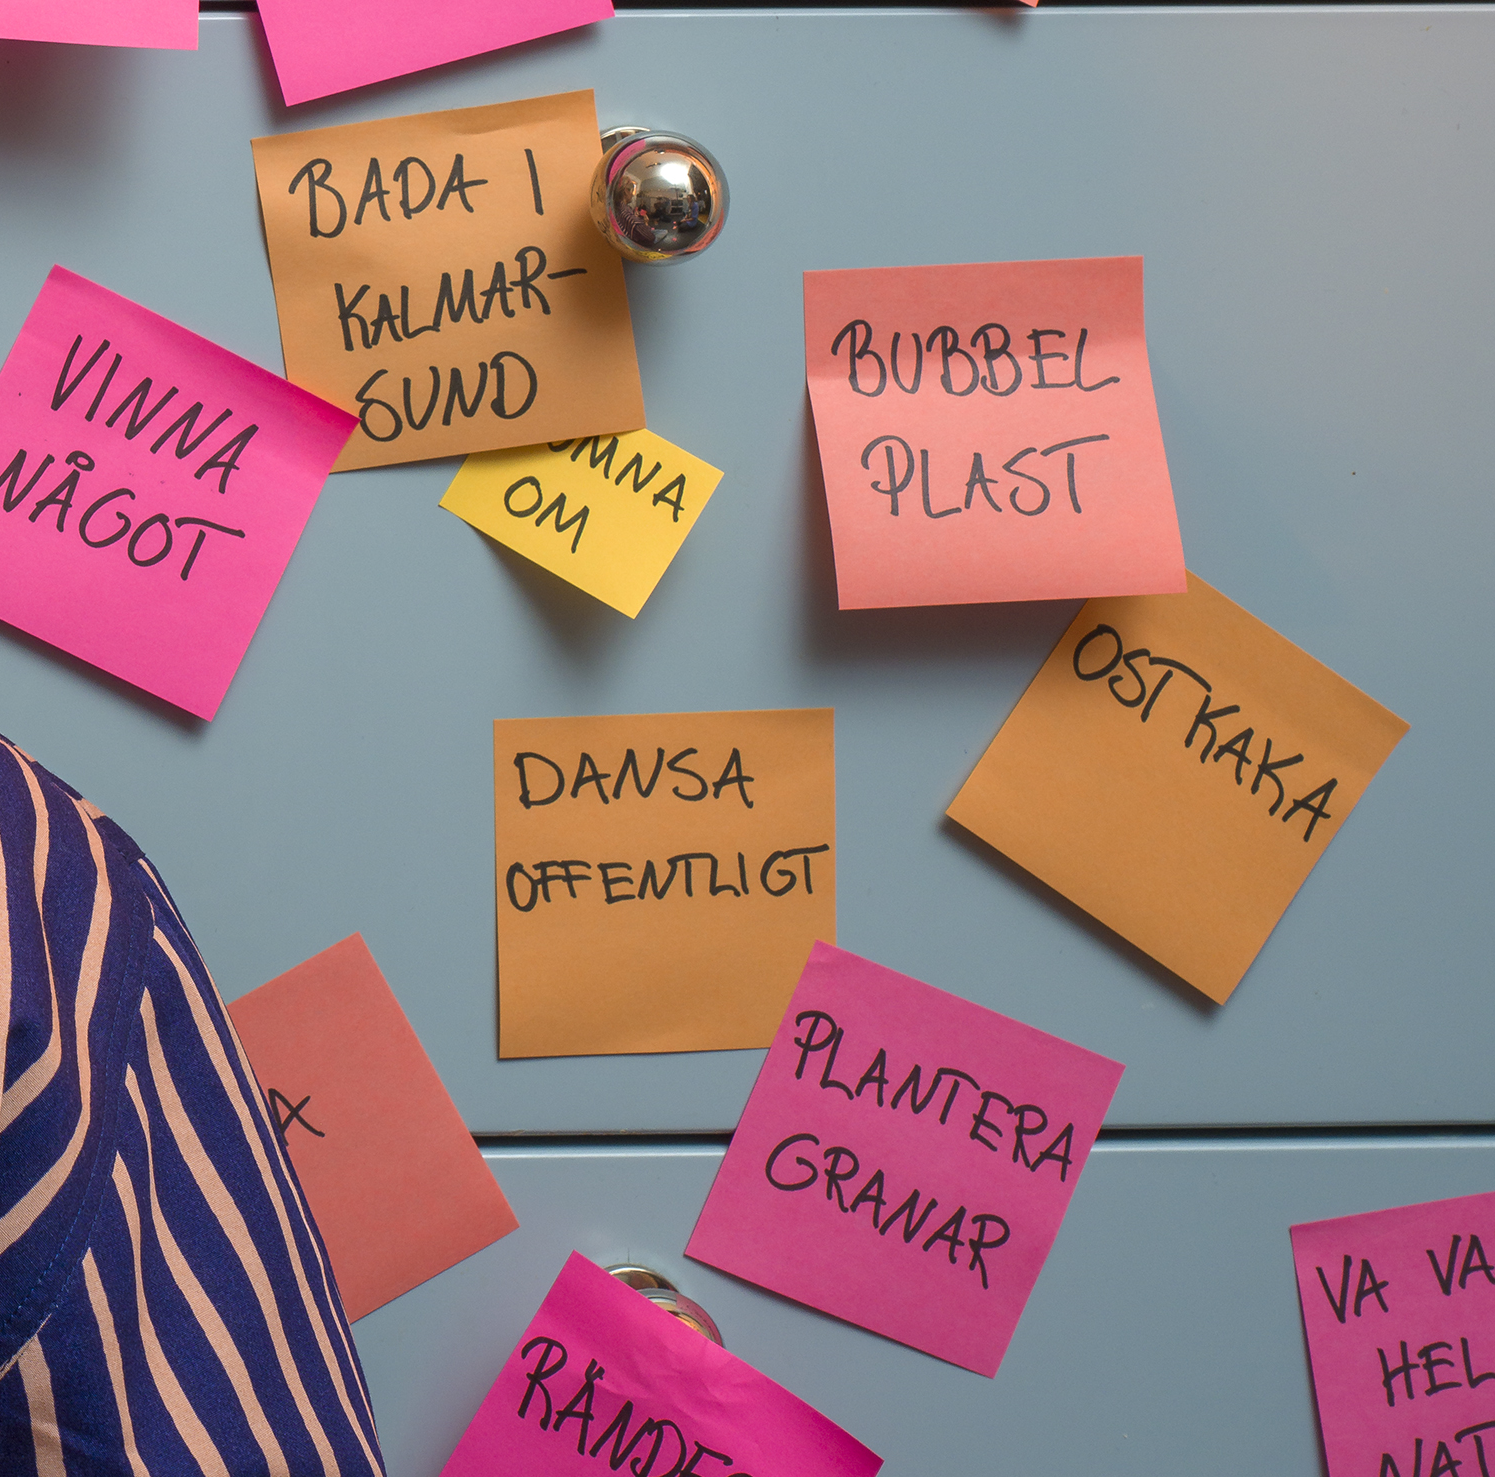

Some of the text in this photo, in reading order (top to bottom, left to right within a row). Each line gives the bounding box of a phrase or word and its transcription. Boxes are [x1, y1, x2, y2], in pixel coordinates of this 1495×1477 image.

[288, 149, 544, 238] BADA I
[334, 246, 586, 351] KALMAR-
[355, 351, 538, 442] SUND
[831, 319, 1120, 397] BUBBEL
[51, 335, 259, 494] VINNA
[504, 476, 590, 554] OM
[861, 434, 1110, 519] PLAST
[514, 747, 754, 809] DANSA
[506, 844, 830, 912] OFFENTLIGT
[794, 1010, 1074, 1182] PLANTERA
[765, 1133, 1010, 1289] GRANAR
[1315, 1234, 1495, 1324] VA VA
[1376, 1337, 1495, 1408] HEL
